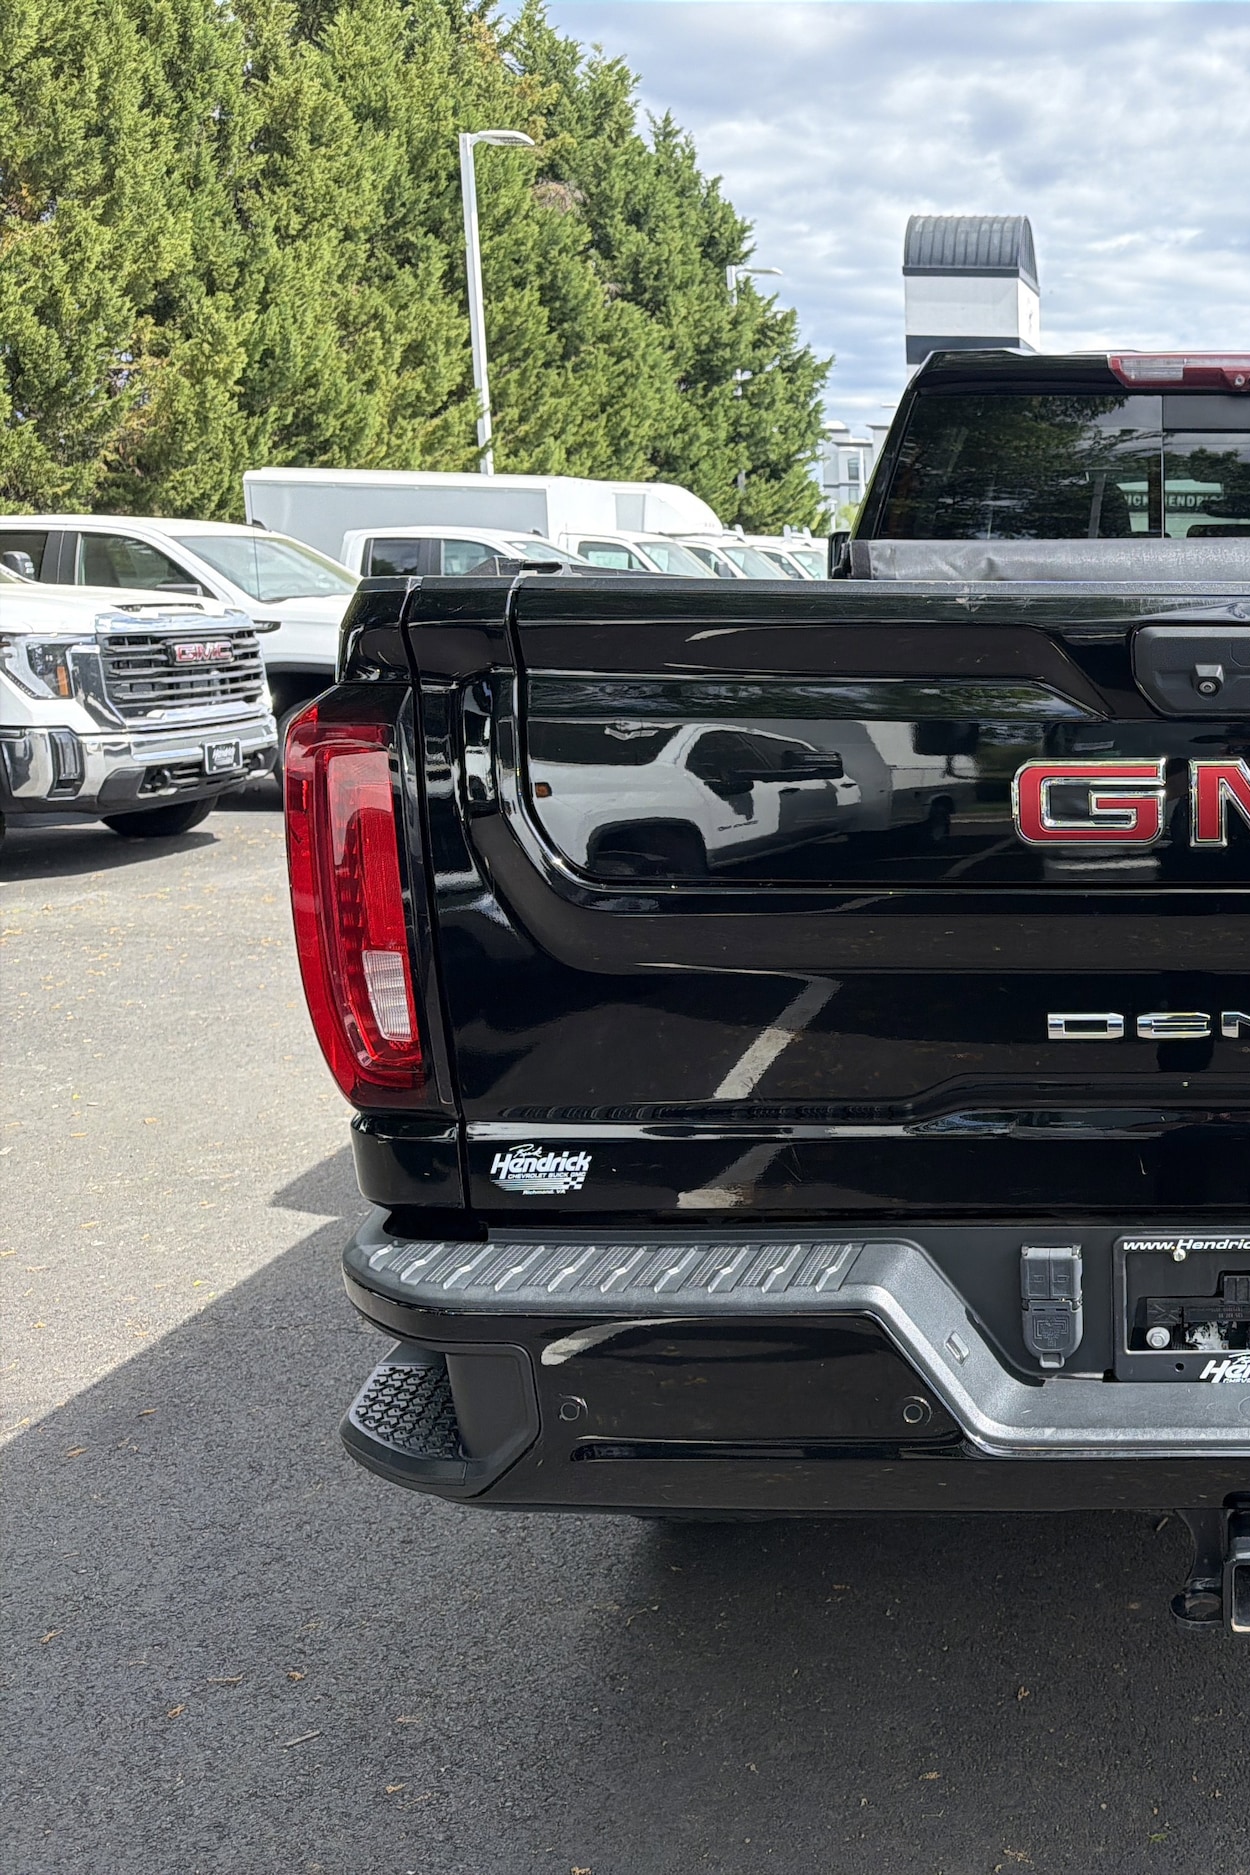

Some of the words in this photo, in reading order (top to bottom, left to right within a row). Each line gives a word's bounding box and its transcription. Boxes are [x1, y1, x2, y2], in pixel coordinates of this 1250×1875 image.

[174, 641, 232, 662] GMC
[490, 1151, 593, 1180] Hendrick
[507, 1172, 547, 1180] CHEVROLET
